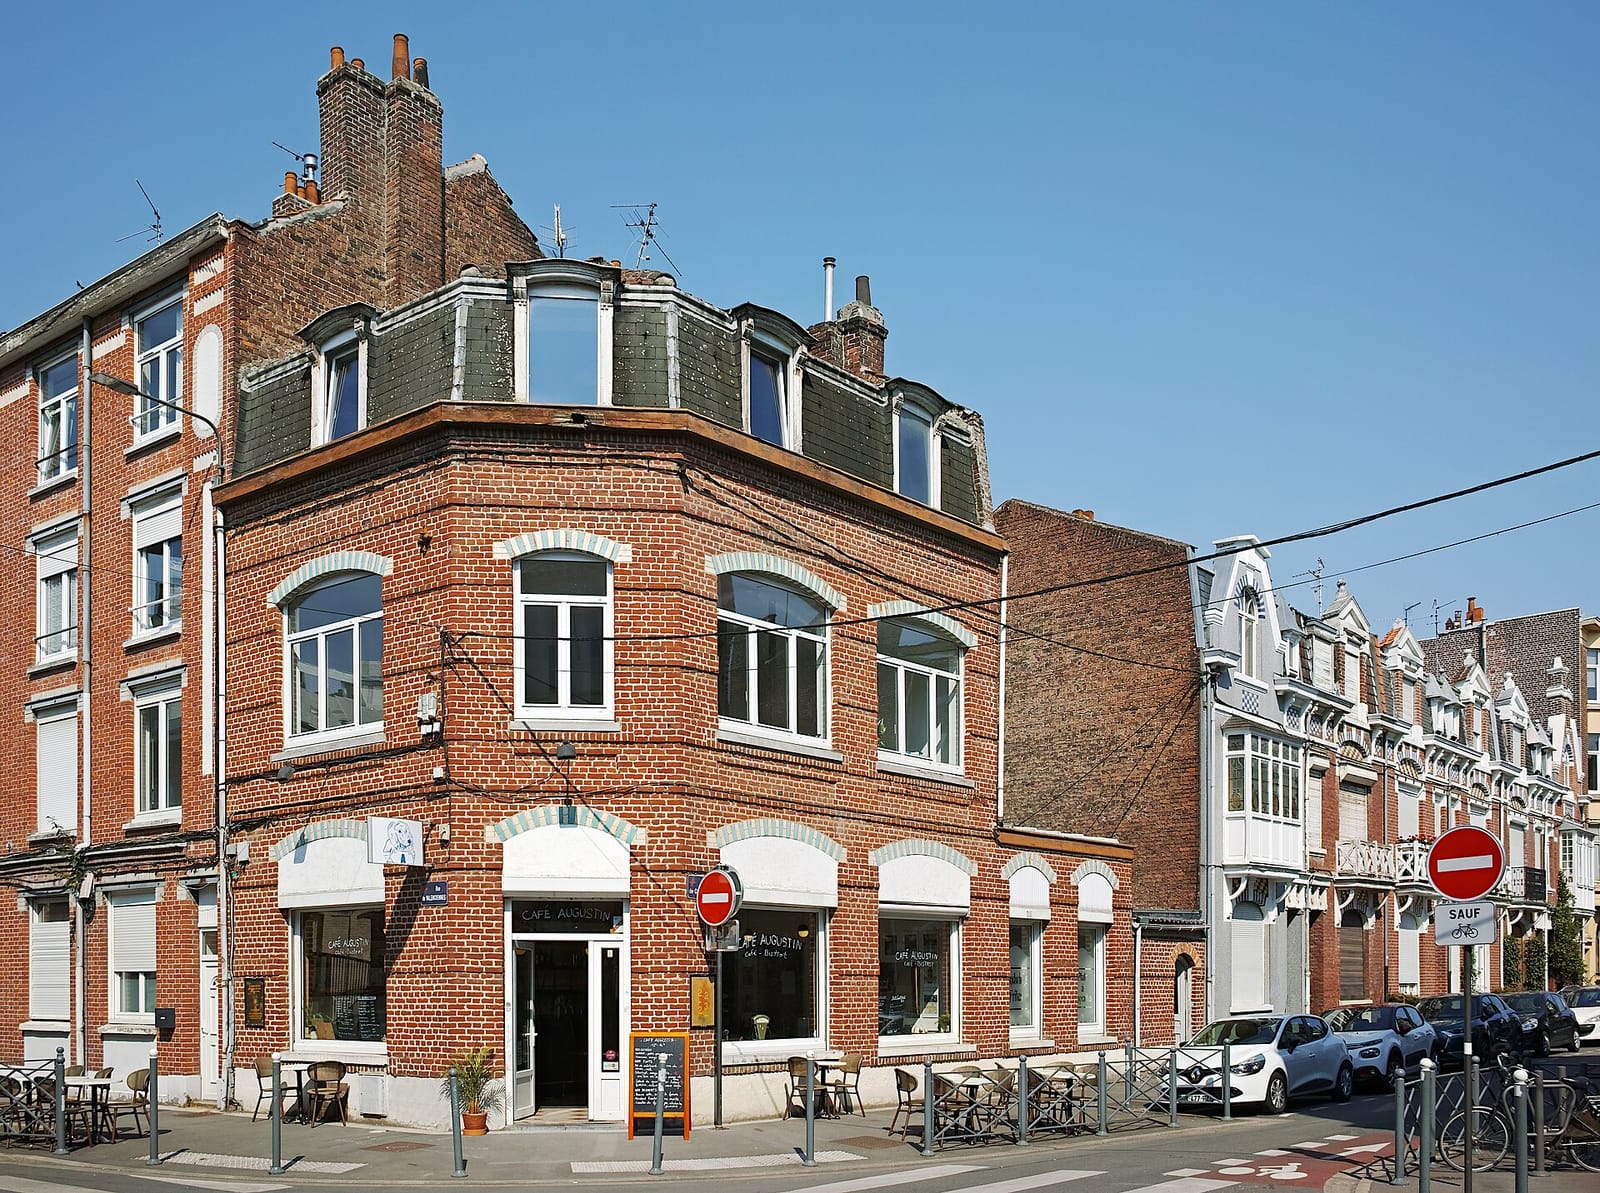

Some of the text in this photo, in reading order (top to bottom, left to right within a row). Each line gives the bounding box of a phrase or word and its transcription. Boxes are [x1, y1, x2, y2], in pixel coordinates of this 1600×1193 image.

[522, 905, 611, 921] CAFÉ AUGUSTIN
[1448, 907, 1481, 920] SAUF
[760, 933, 803, 950] AUGUSTIN
[910, 951, 938, 961] AUGUSTIN
